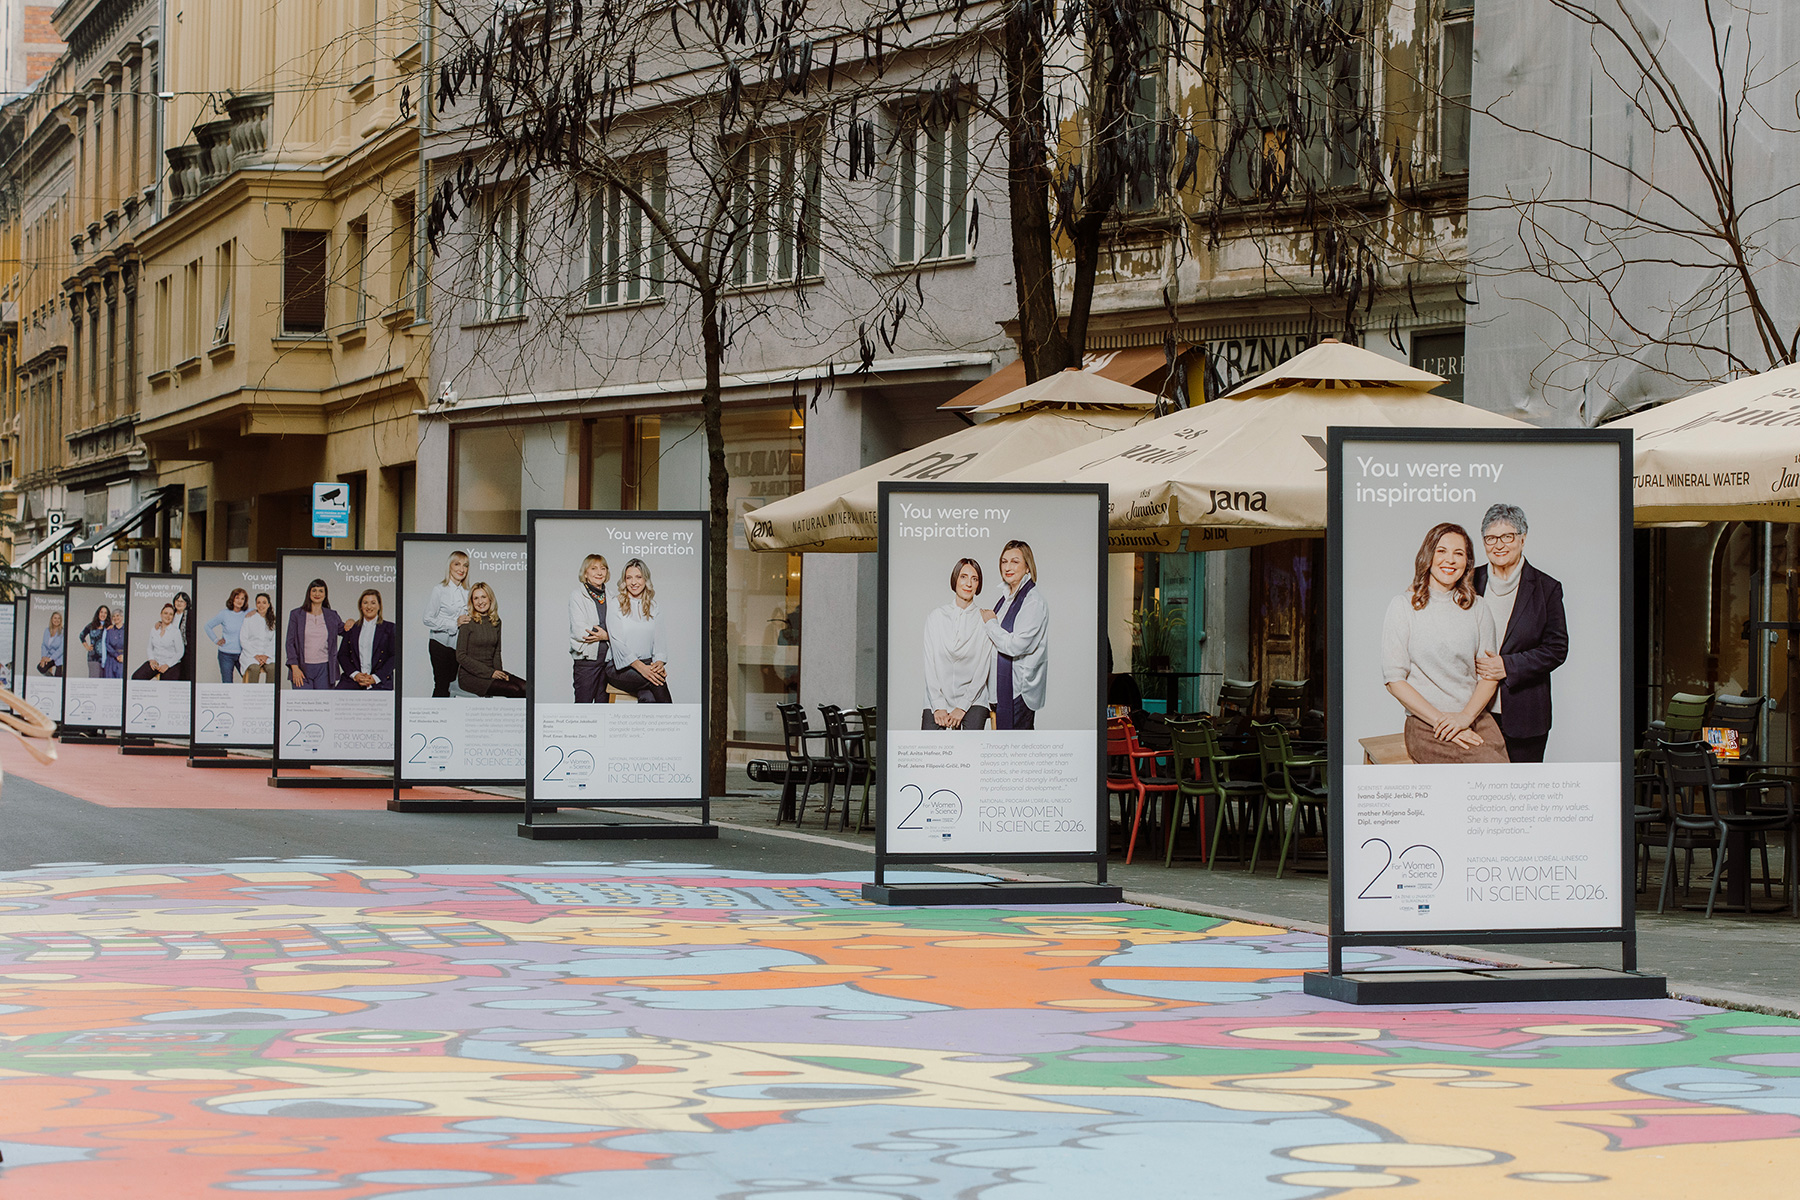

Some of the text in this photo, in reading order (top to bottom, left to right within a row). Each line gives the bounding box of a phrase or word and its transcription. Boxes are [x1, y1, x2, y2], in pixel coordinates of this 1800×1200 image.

[1356, 456, 1504, 483] You were my
[1666, 473, 1710, 488] MINERAL
[1713, 471, 1750, 486] WATER
[1356, 482, 1476, 507] inspiration
[1206, 490, 1268, 515] Jana
[899, 503, 1011, 524] You were my
[792, 517, 827, 533] NATURAL
[828, 513, 859, 526] MINERAL
[606, 527, 694, 544] You were my
[899, 522, 990, 541] inspiration
[50, 513, 61, 585] OPIKA
[466, 548, 487, 559] You
[622, 542, 694, 557] inspiration
[334, 562, 353, 572] You
[355, 564, 380, 572] were
[242, 572, 259, 581] You
[135, 582, 149, 590] You
[104, 591, 117, 599] You
[134, 590, 174, 598] inspiration
[334, 733, 351, 741] FOR
[464, 748, 522, 756] FOR WOMEN
[464, 758, 473, 766] IN
[476, 758, 513, 766] SCIENCE
[608, 763, 675, 772] FOR WOMEN
[1020, 768, 1043, 776] inspired
[1043, 768, 1062, 776] lasting
[608, 773, 694, 784] IN SCIENCE 2026.
[1510, 782, 1535, 790] taught
[1376, 792, 1392, 800] Šoljić
[1518, 793, 1545, 801] explore
[1547, 792, 1564, 800] with
[979, 806, 1064, 818] FOR WOMEN
[1467, 804, 1508, 813] dedication,
[1509, 804, 1525, 812] and
[1526, 803, 1539, 812] live
[1540, 804, 1550, 813] by
[1552, 804, 1564, 813] my
[1467, 815, 1481, 823] She
[1490, 817, 1505, 825] my
[1504, 815, 1536, 825] greatest
[1537, 814, 1551, 822] role
[1553, 814, 1577, 822] model
[1578, 814, 1594, 822] and
[979, 820, 1087, 832] IN SCIENCE 2026.
[1467, 826, 1484, 836] daily
[1402, 861, 1435, 869] Women
[1408, 870, 1438, 878] Science
[1466, 865, 1577, 882] FOR WOMEN
[1466, 884, 1608, 902] IN SCIENCE 2026.
